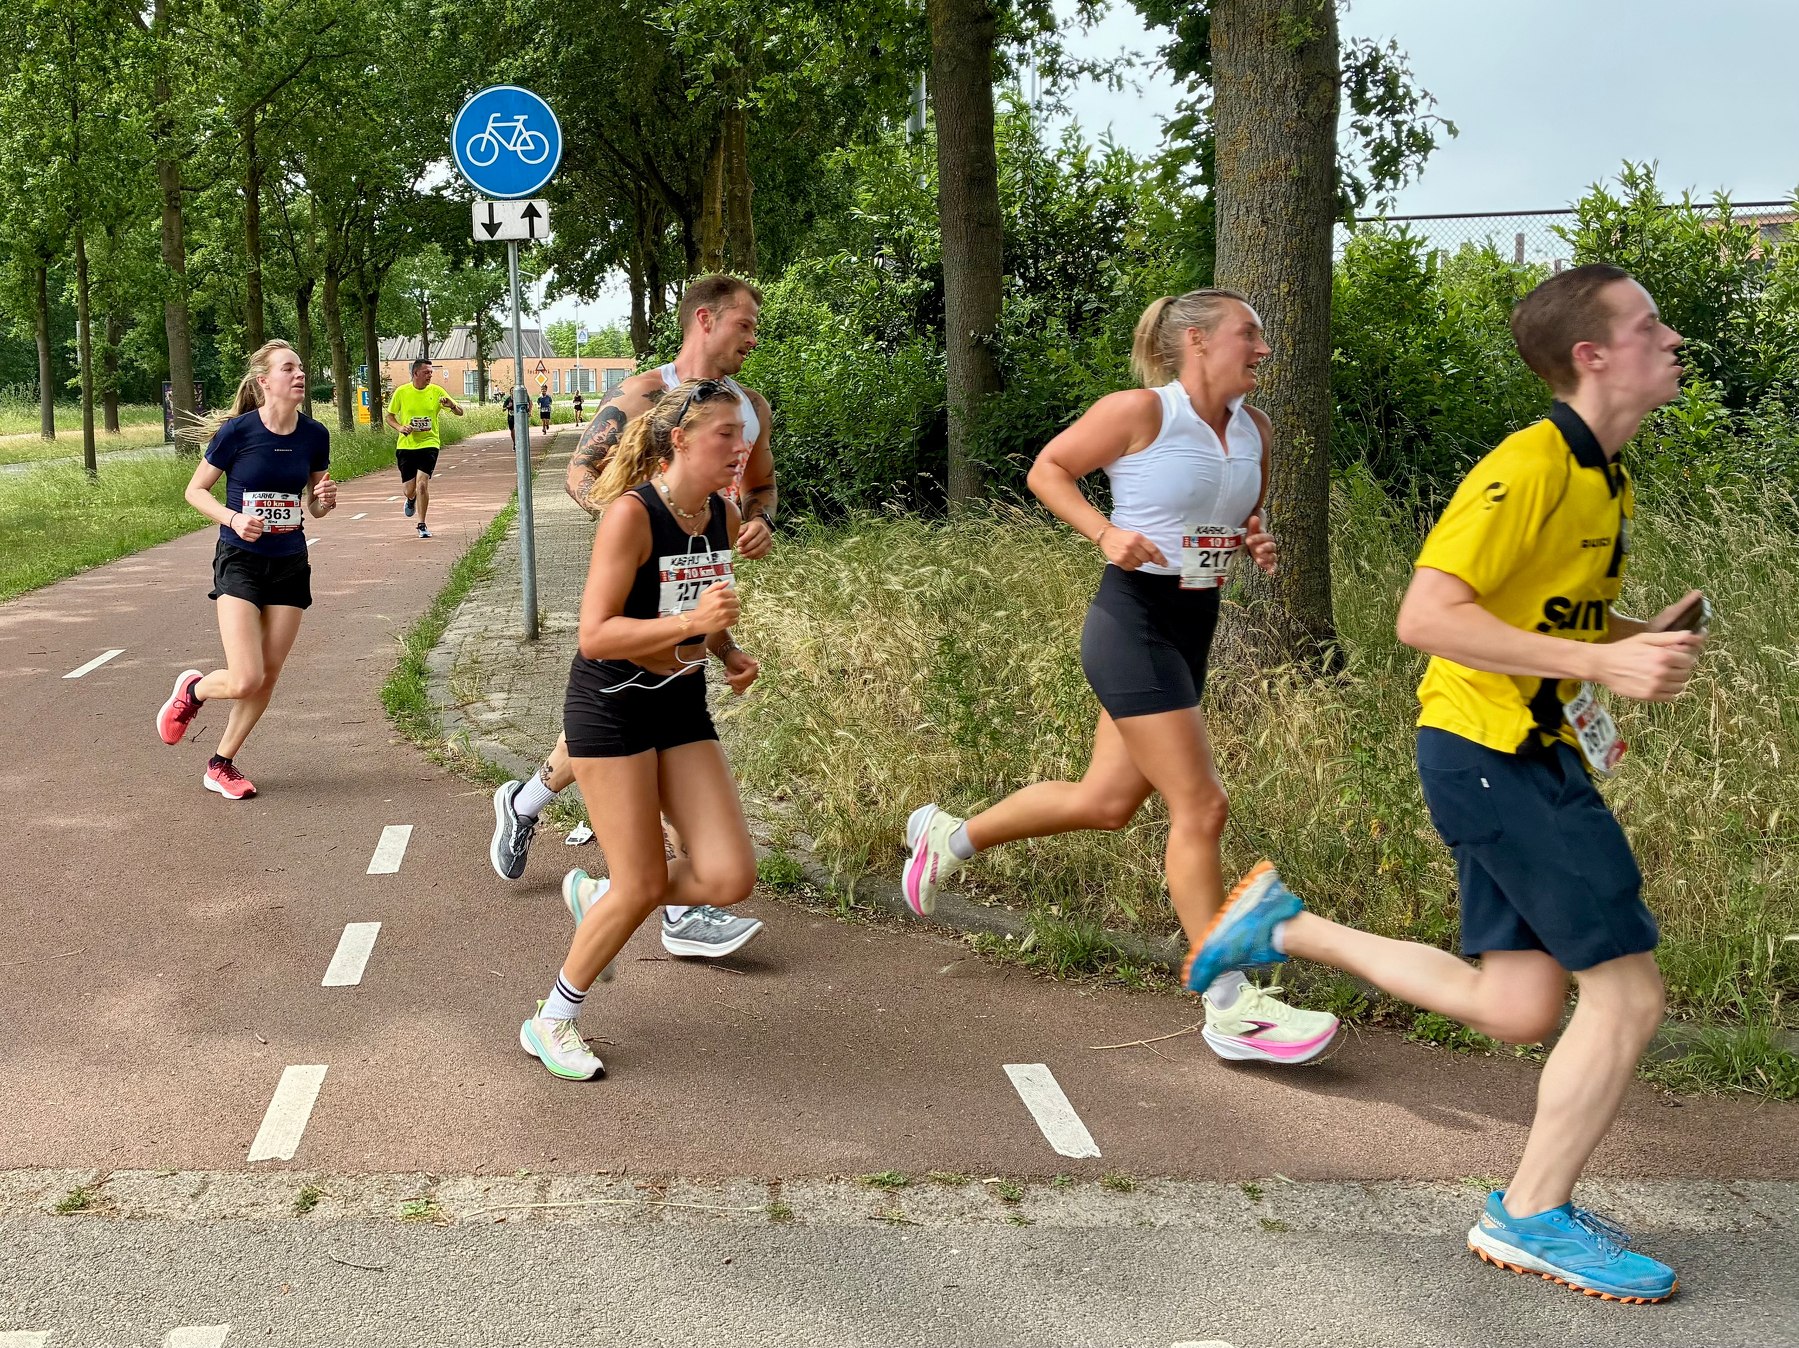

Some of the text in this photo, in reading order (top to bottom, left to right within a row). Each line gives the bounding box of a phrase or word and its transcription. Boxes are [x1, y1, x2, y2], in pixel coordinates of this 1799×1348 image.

[255, 509, 291, 520] 2363
[1209, 537, 1223, 547] 10
[1199, 550, 1238, 568] 217
[677, 579, 722, 601] 277
